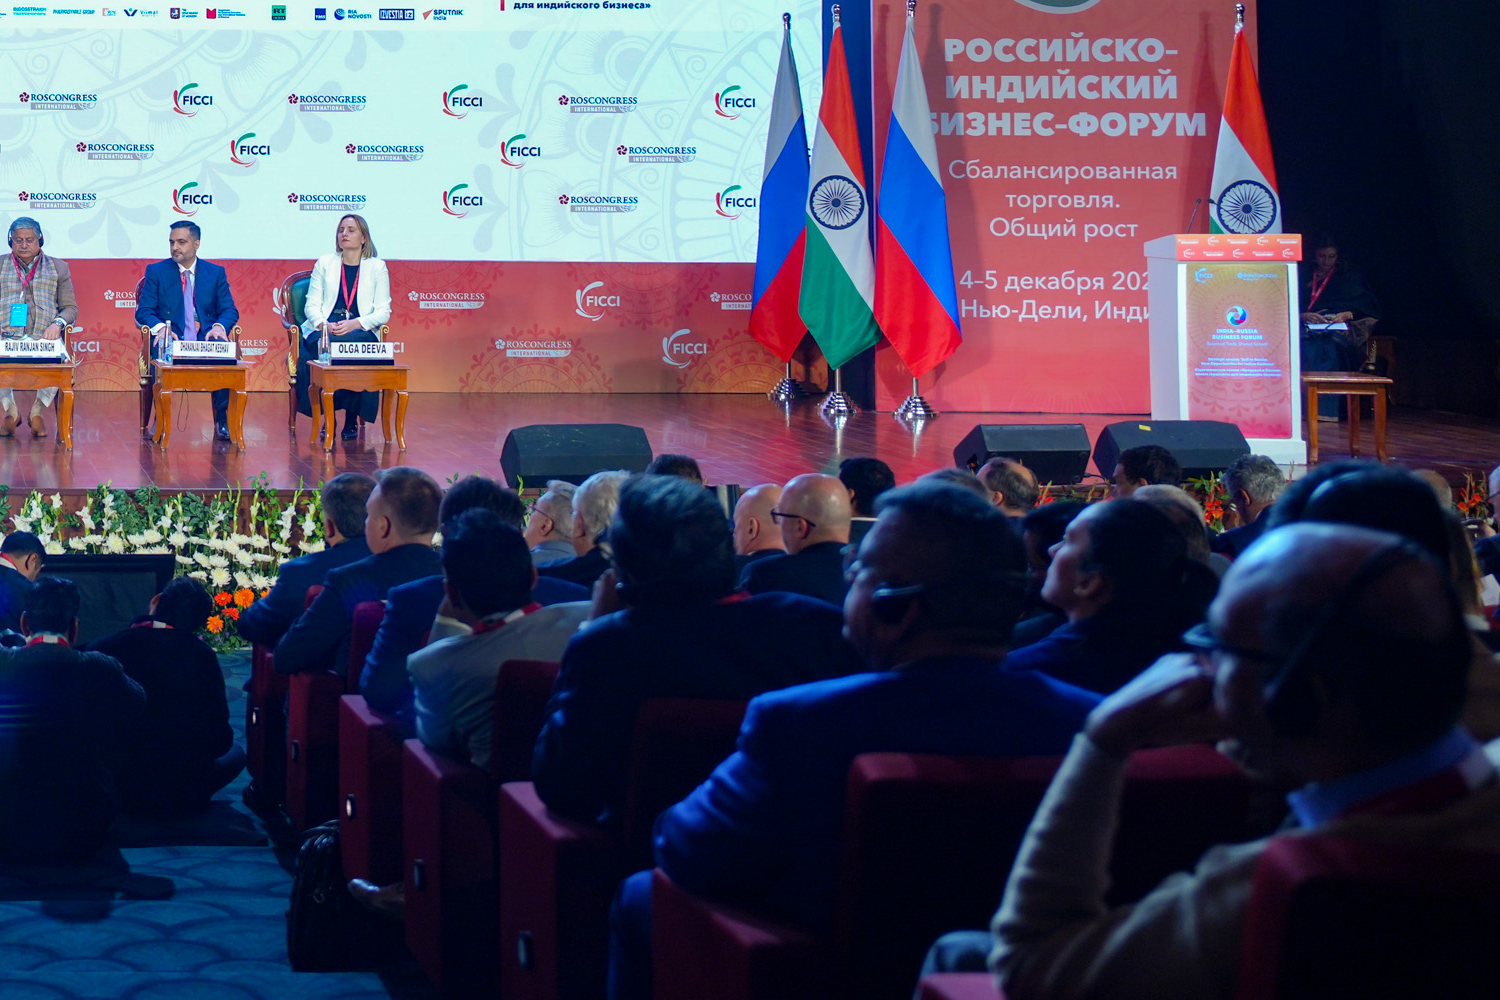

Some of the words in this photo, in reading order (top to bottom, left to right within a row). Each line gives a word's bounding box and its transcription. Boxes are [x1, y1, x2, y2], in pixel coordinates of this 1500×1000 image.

[514, 1, 534, 10] для
[537, 0, 600, 10] индийского
[603, 1, 651, 10] бизнеса»
[380, 9, 403, 19] IZVESTIA
[945, 32, 1178, 62] РОССИЙСКО-
[946, 69, 1177, 103] ИНДИЙСКИЙ
[31, 93, 97, 102] ROSCONGRESS
[300, 95, 366, 104] ROSCONGRESS
[570, 96, 637, 105] ROSCONGRESS
[88, 143, 154, 152] ROSCONGRESS
[357, 145, 424, 154] ROSCONGRESS
[949, 159, 1177, 181] Сбалансированная
[30, 192, 96, 201] ROSCONGRESS
[300, 194, 366, 203] ROSCONGRESS
[570, 196, 638, 205] ROSCONGRESS
[1006, 191, 1121, 213] торговля.
[989, 216, 1077, 238] Общий
[1084, 221, 1138, 243] рост
[1005, 270, 1104, 295] декабря
[1112, 271, 1149, 291] 202
[587, 295, 620, 307] FICCI
[961, 299, 1087, 322] Нью-Дели,
[5, 342, 19, 351] RAJIV
[20, 342, 39, 351] RANJAN
[40, 343, 54, 351] SINGH
[339, 344, 359, 353] OLGA
[362, 344, 386, 353] DEEVA
[506, 340, 571, 349] ROSCONGRESS
